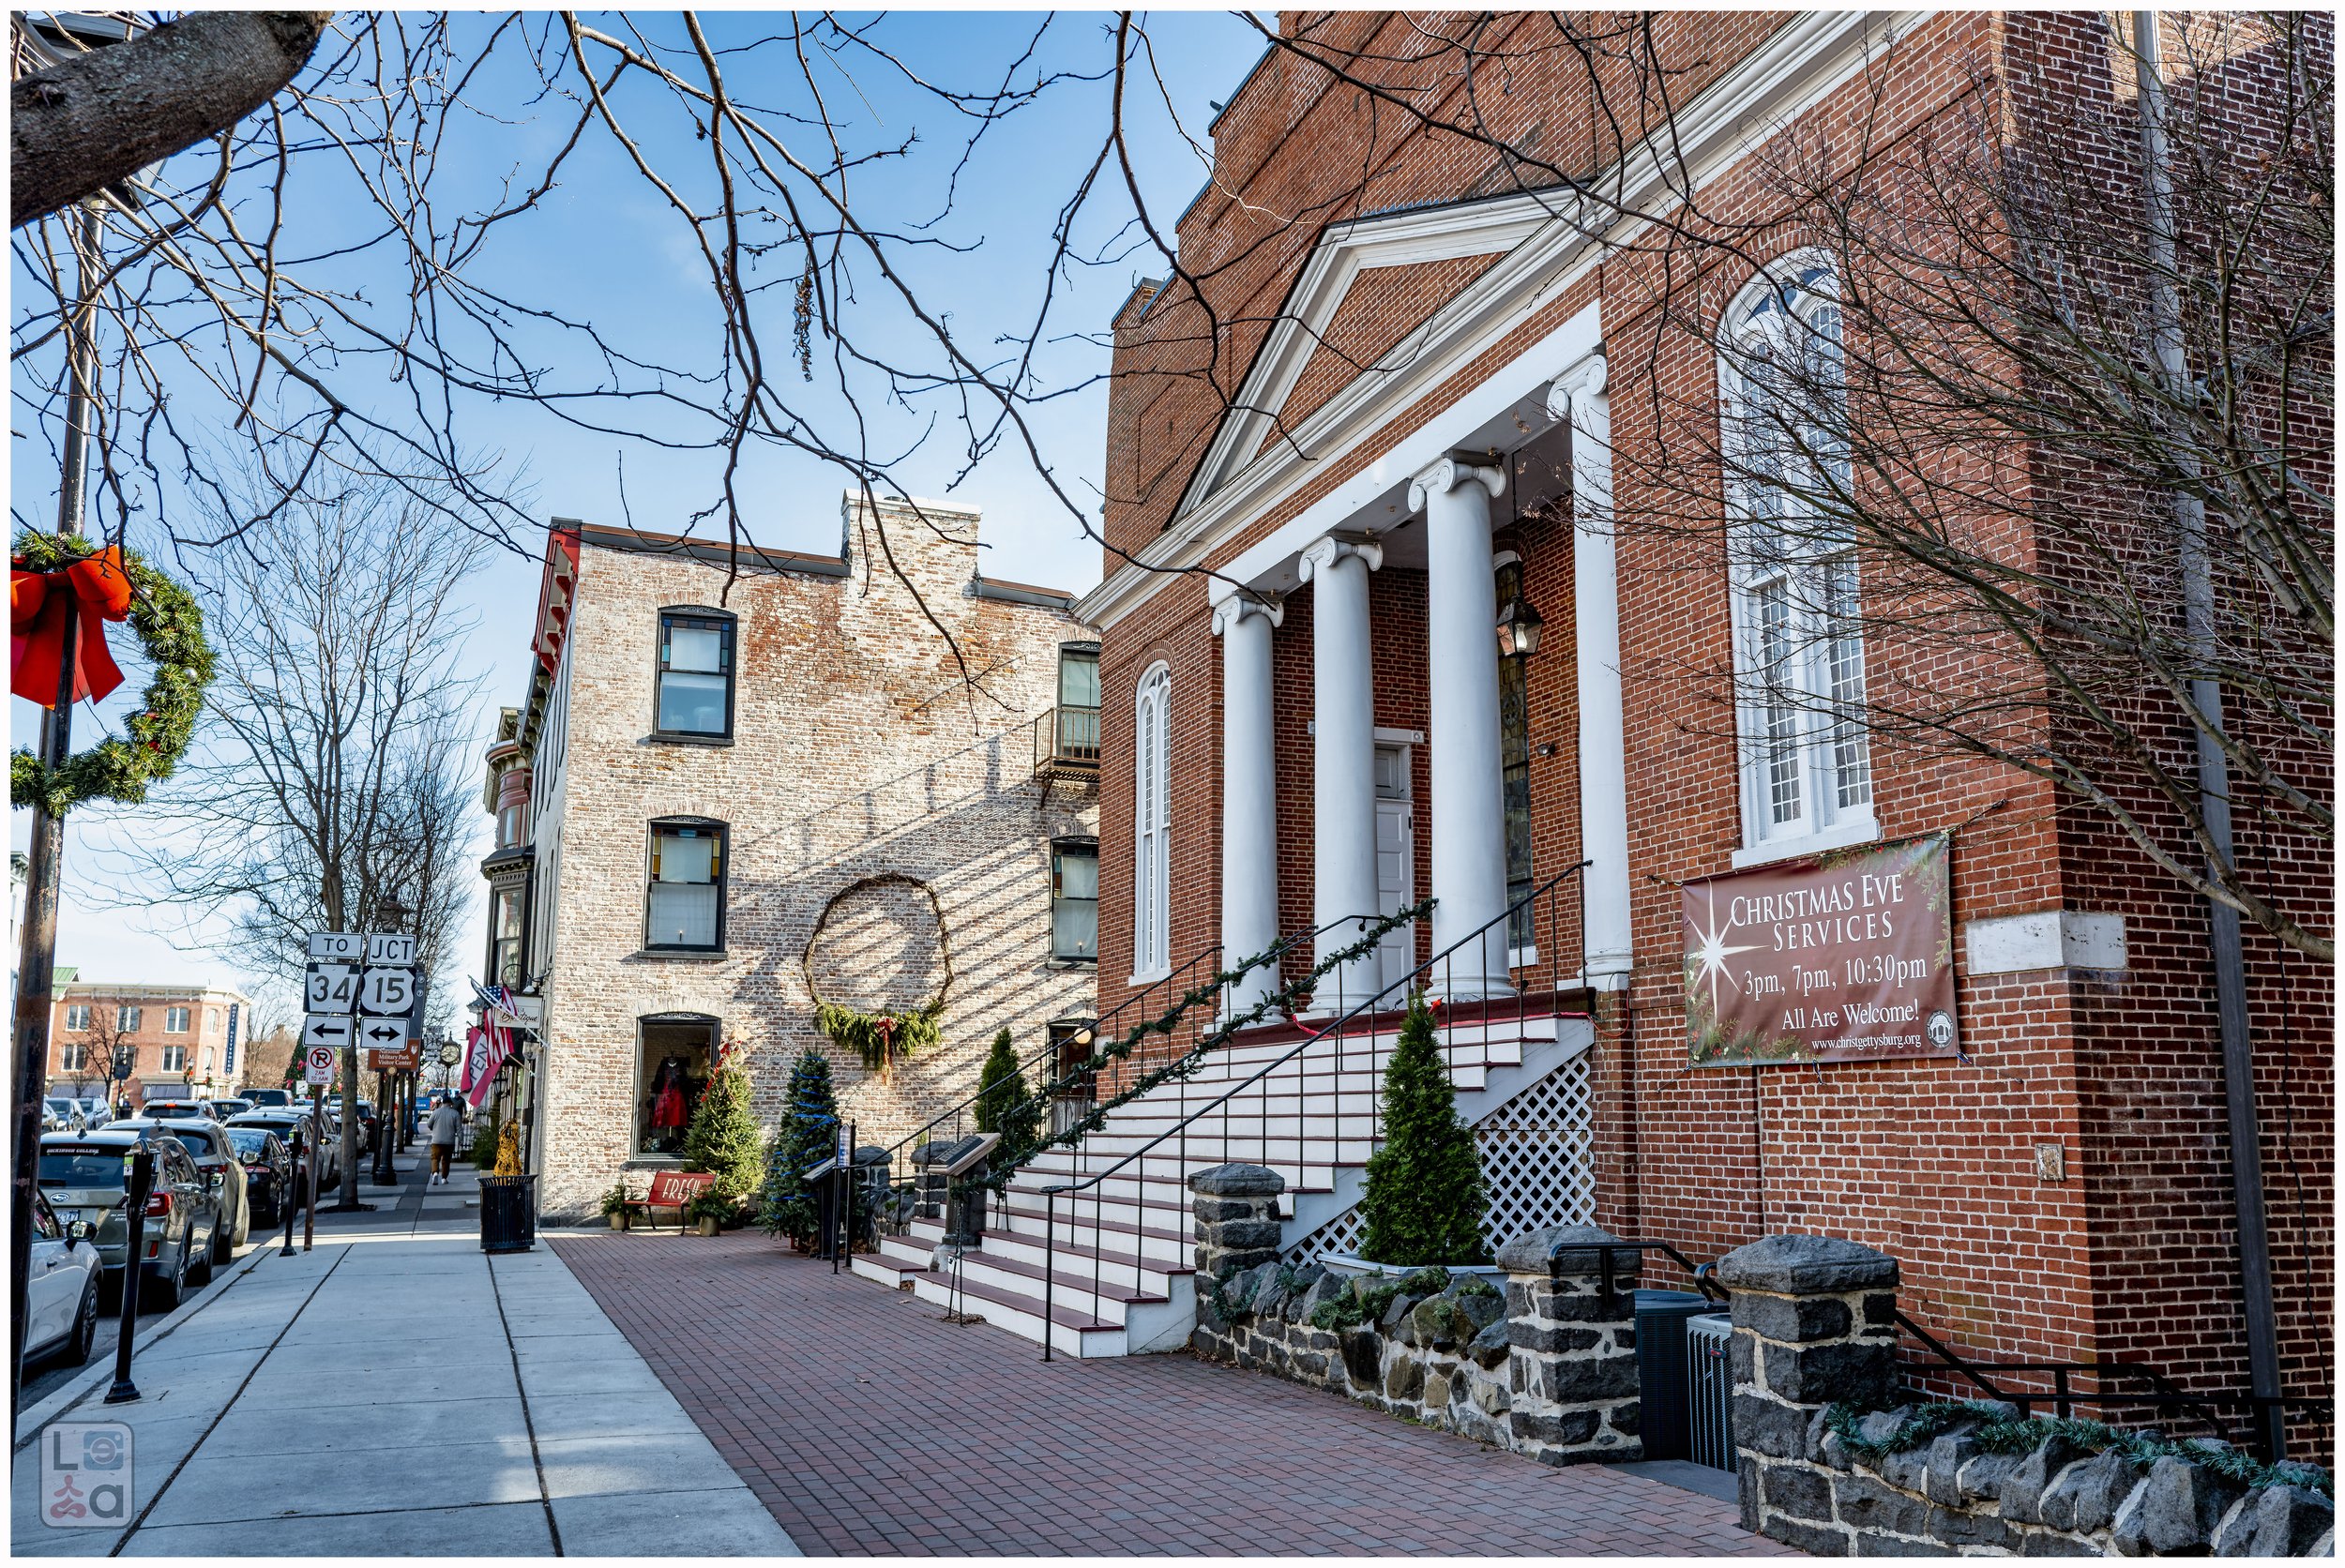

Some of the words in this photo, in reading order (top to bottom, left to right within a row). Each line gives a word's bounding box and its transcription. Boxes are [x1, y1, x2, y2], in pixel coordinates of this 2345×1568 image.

[1730, 882, 1853, 927] CHRISTMAS
[1861, 873, 1904, 906] EVE
[324, 938, 348, 952] TO
[1773, 911, 1893, 952] SERVICES
[371, 940, 412, 960] JCT
[312, 975, 350, 1003] 34
[376, 977, 404, 1003] 15
[1745, 971, 1786, 1002] 3pm,
[1793, 964, 1837, 998] 7pm,
[1845, 954, 1928, 988] 10:30pm
[1782, 1008, 1806, 1030] All
[1811, 1005, 1839, 1028] Are
[1842, 999, 1920, 1024] Welcome!
[1812, 1033, 1921, 1051] www.christgettysburg.org
[469, 1042, 489, 1080] PEN
